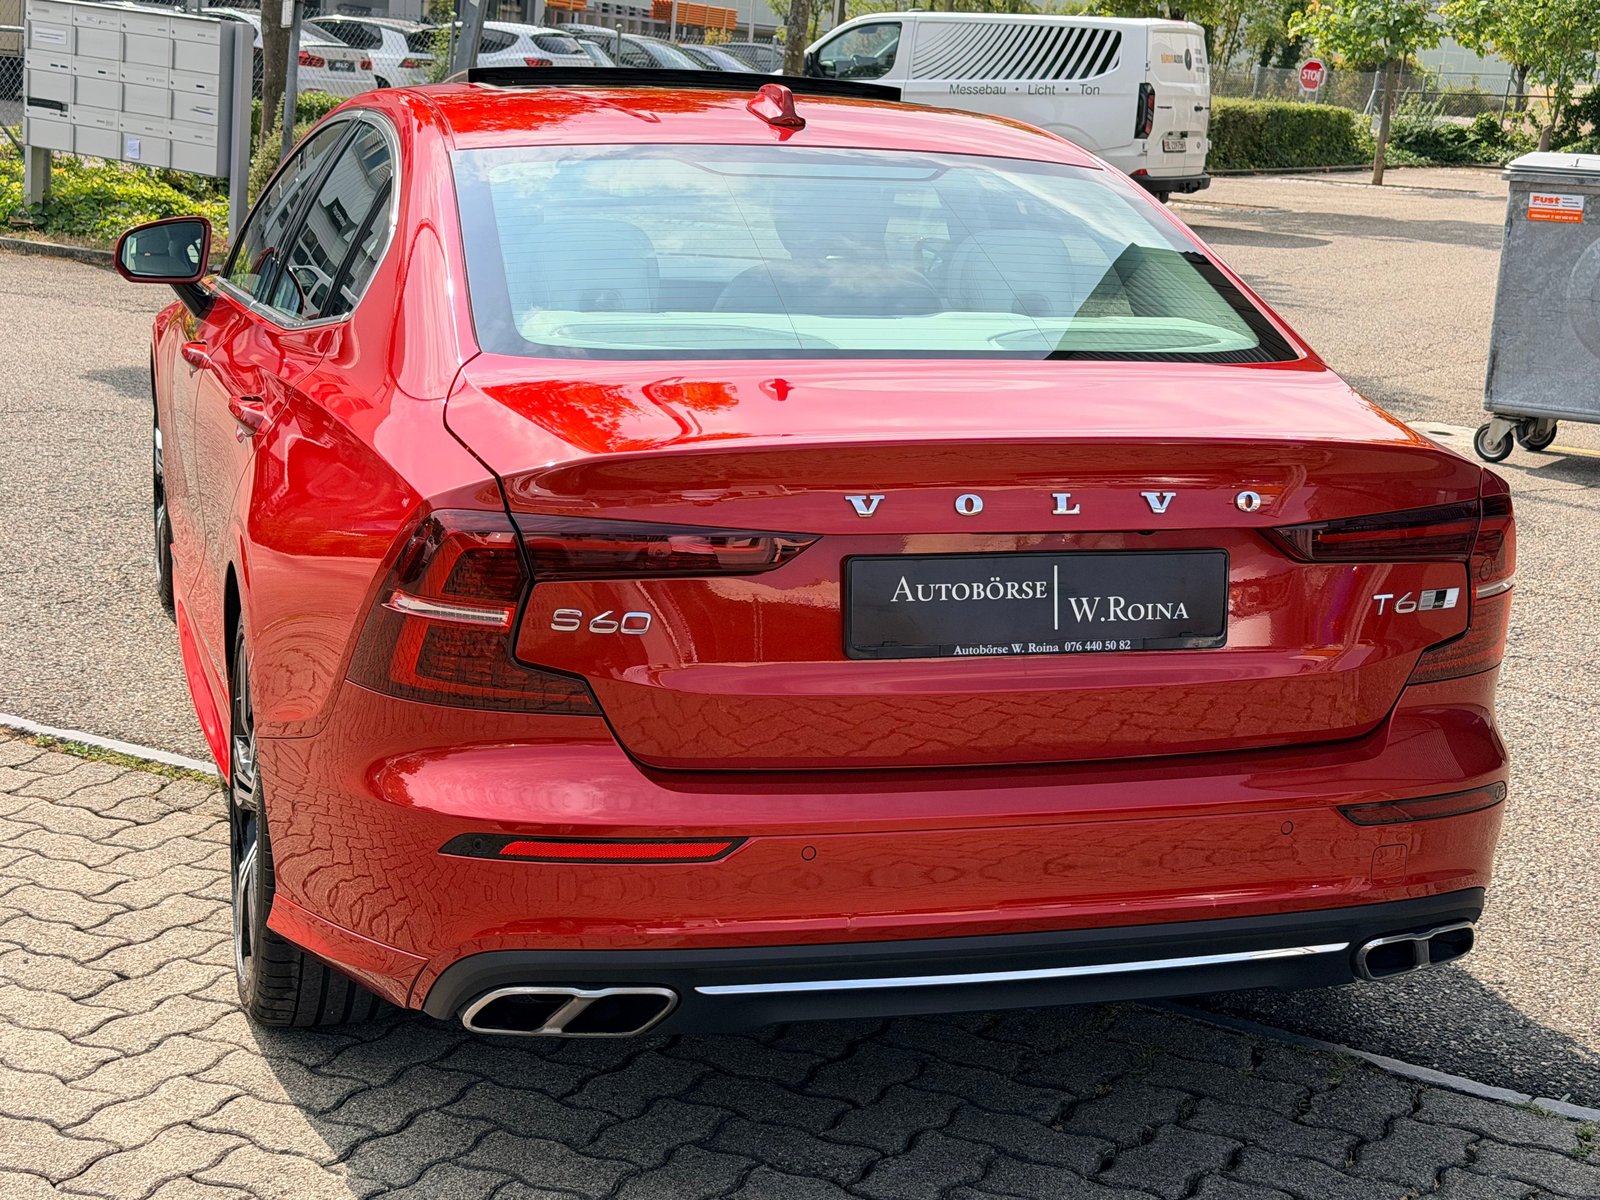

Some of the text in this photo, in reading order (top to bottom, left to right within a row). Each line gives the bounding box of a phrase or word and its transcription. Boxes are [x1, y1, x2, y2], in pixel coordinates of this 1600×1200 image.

[1301, 69, 1319, 81] STO
[949, 83, 1100, 95] Messebau Licht Ton
[845, 490, 1262, 518] VOLVO
[1373, 591, 1417, 616] T6
[550, 608, 652, 635] S60
[953, 639, 1131, 656] Autobörse W. Roina 076 440 50 82
